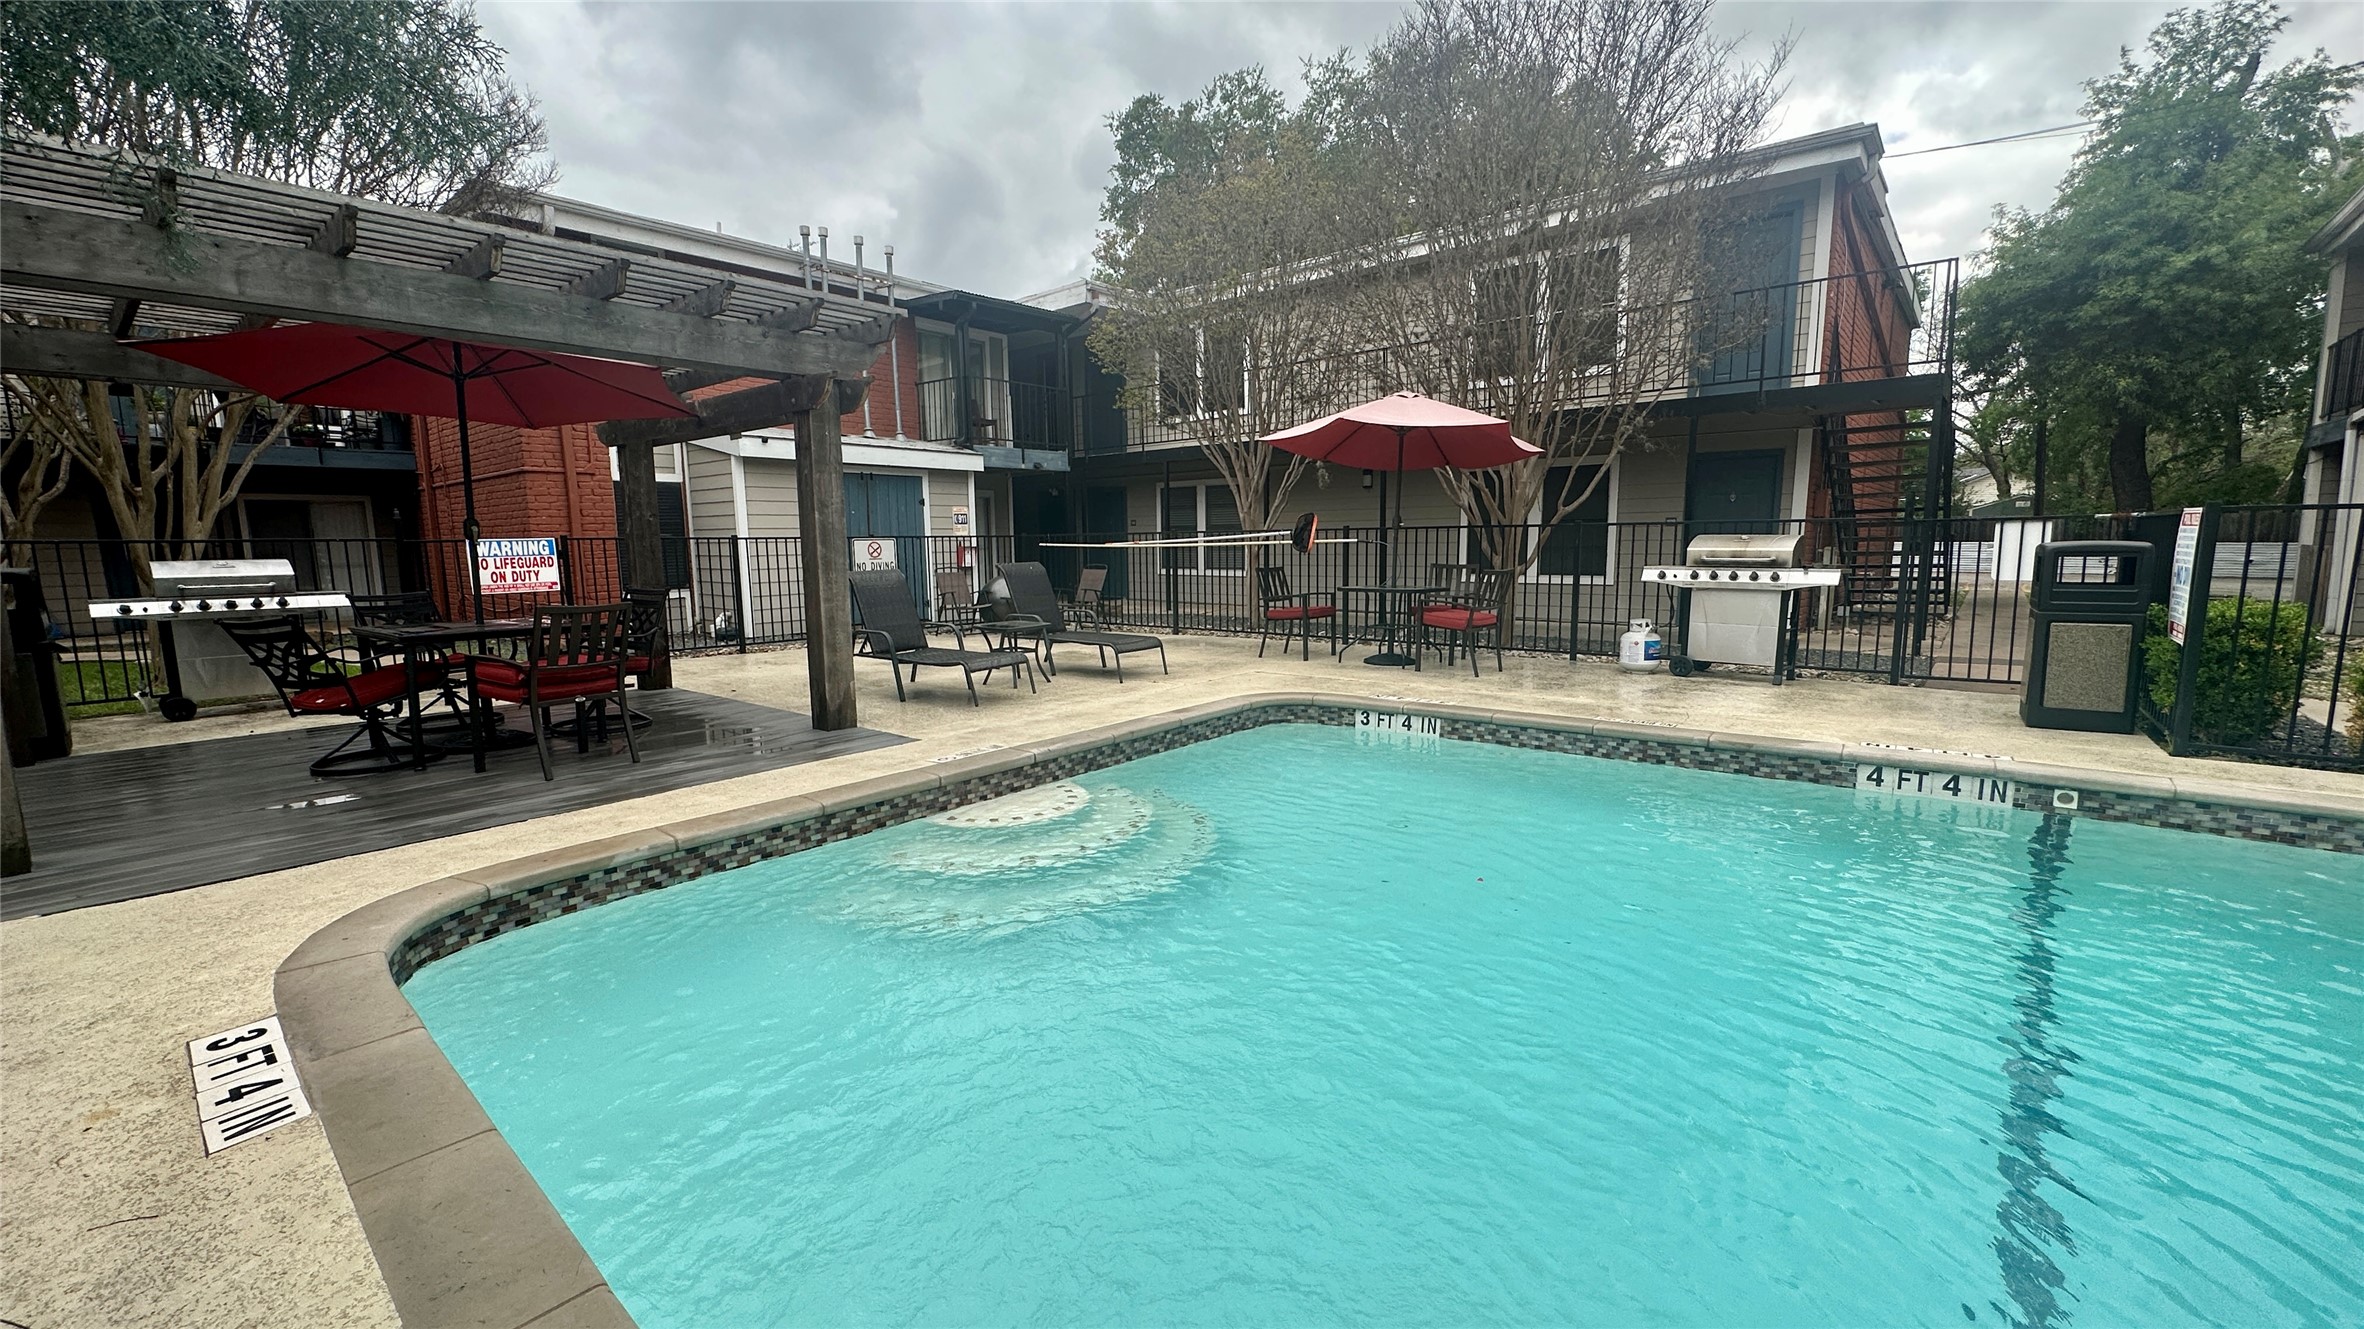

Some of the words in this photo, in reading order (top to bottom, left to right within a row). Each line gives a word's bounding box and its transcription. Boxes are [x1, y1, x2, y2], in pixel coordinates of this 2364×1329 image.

[477, 540, 549, 557] WARNING
[479, 558, 488, 570] O
[494, 556, 554, 570] LIFEGUARD
[856, 562, 867, 571] NO
[870, 561, 895, 571] DIVING
[490, 571, 507, 583] ON
[511, 570, 540, 582] DUTY
[1360, 710, 1370, 726] 3
[1377, 712, 1395, 729] FT
[1401, 715, 1412, 731] 4
[1421, 716, 1437, 734] IN
[1866, 766, 1884, 787] 4
[1897, 769, 1930, 792] FT
[1942, 774, 1961, 796] 4
[1977, 778, 2008, 803] IN
[206, 1028, 268, 1052] 3
[207, 1044, 278, 1081] FT
[215, 1078, 284, 1107] 4
[218, 1096, 296, 1142] IN
